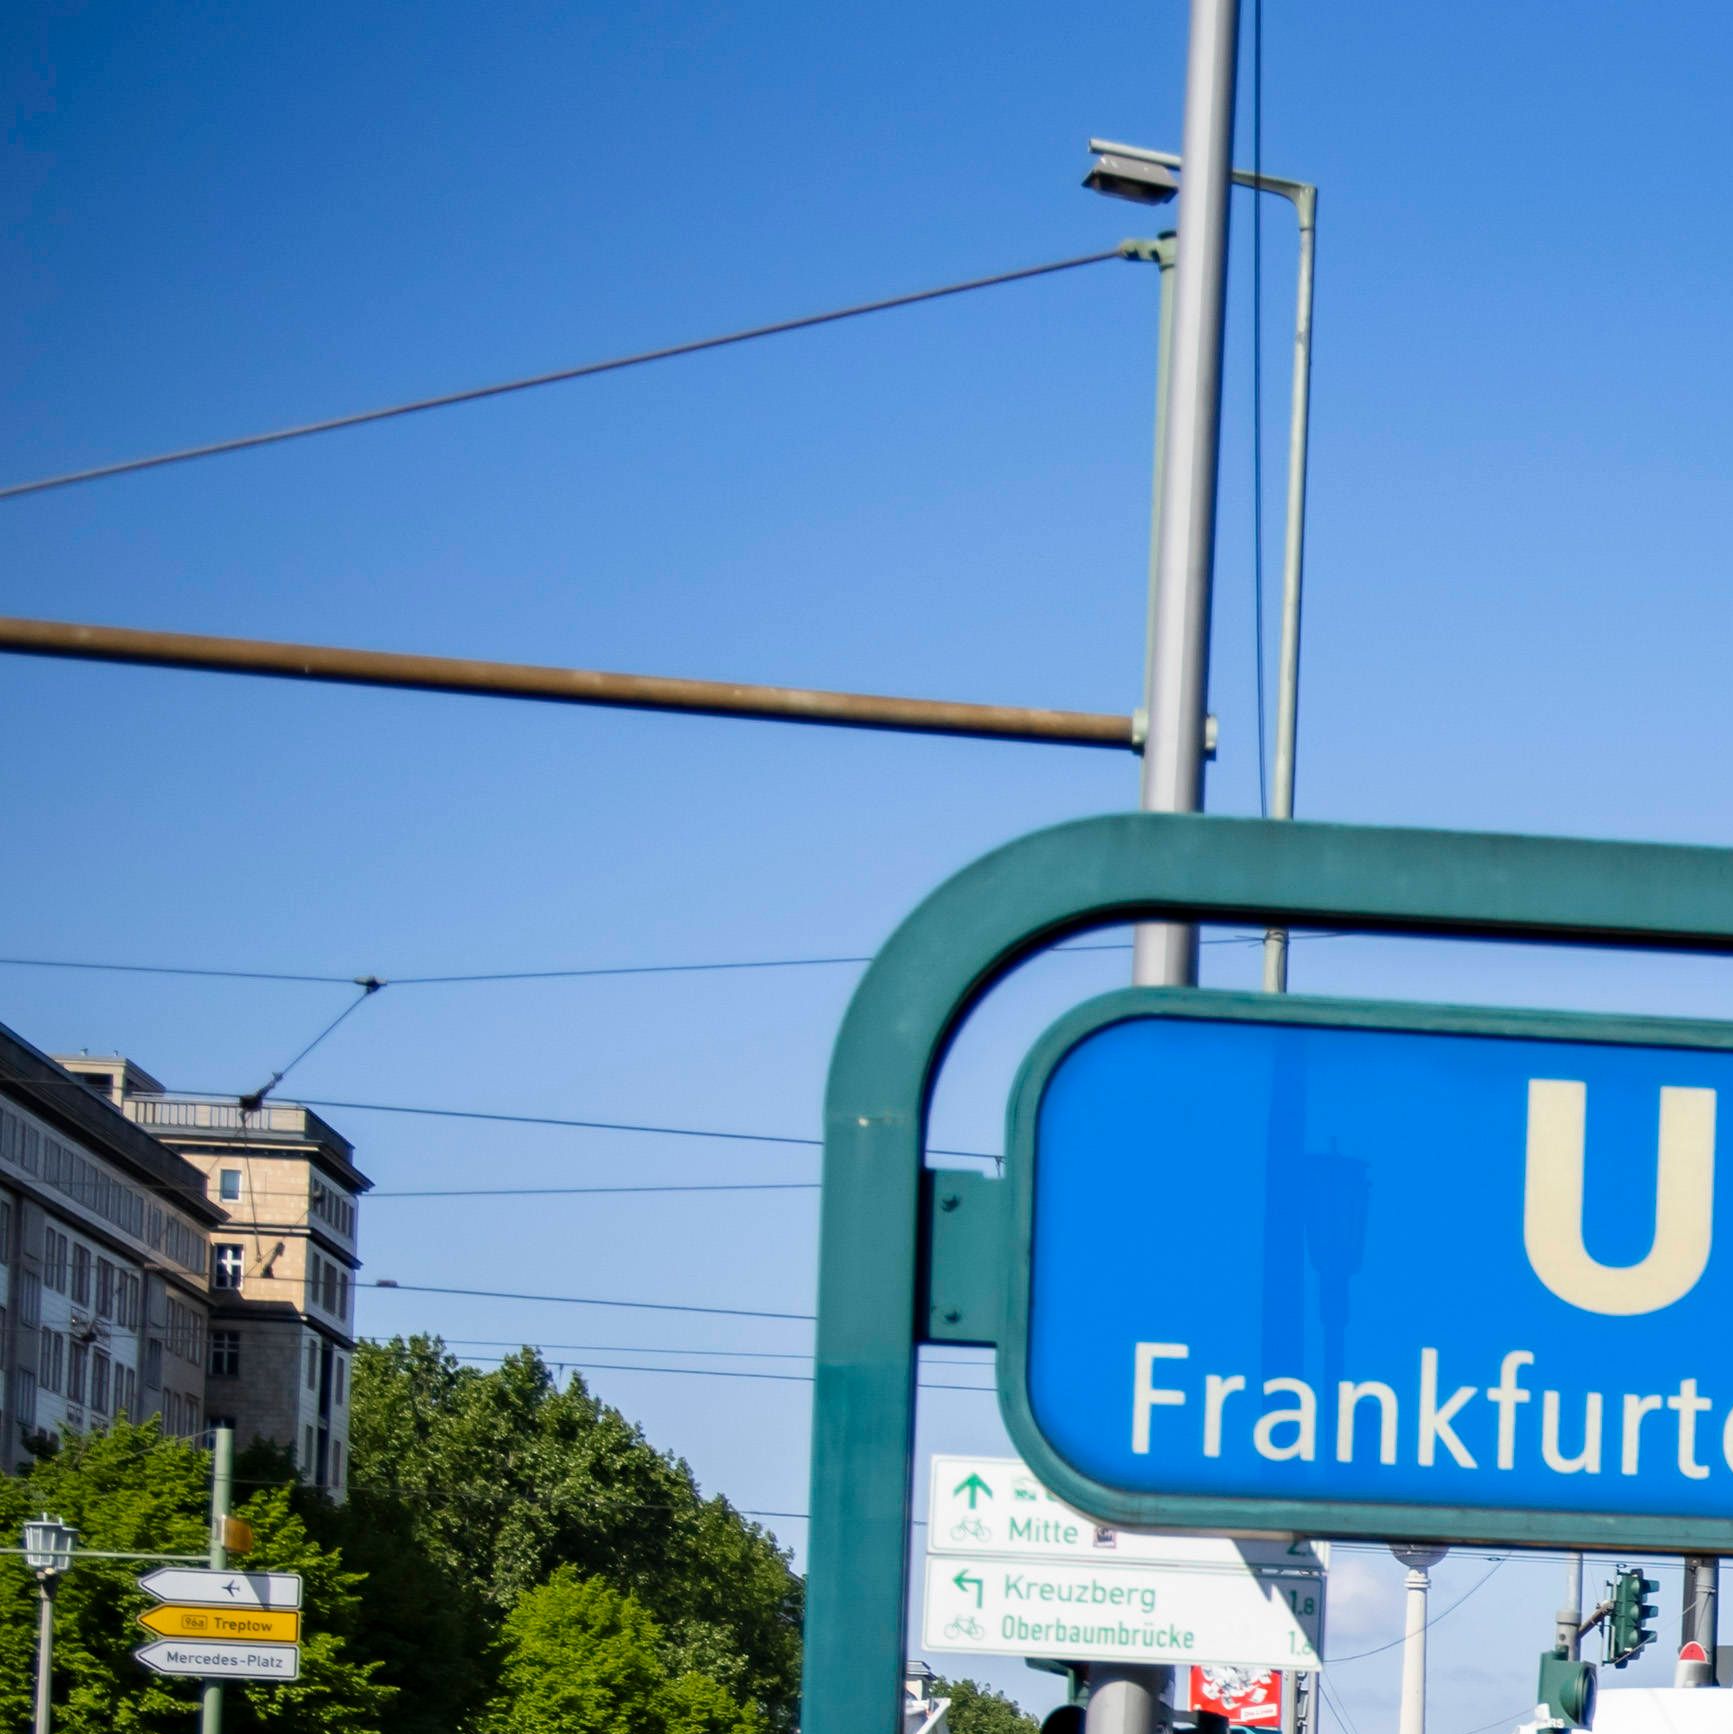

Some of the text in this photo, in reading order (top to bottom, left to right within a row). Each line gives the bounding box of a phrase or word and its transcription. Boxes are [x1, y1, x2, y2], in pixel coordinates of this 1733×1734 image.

[1524, 1078, 1718, 1317] U
[1008, 1516, 1079, 1546] Mitte
[1003, 1573, 1157, 1614] Kreuzberg
[184, 1616, 273, 1634] 96a Treptow
[1001, 1614, 1196, 1650] Oberbaumbrücke
[166, 1650, 284, 1669] Mercedes-Platz
